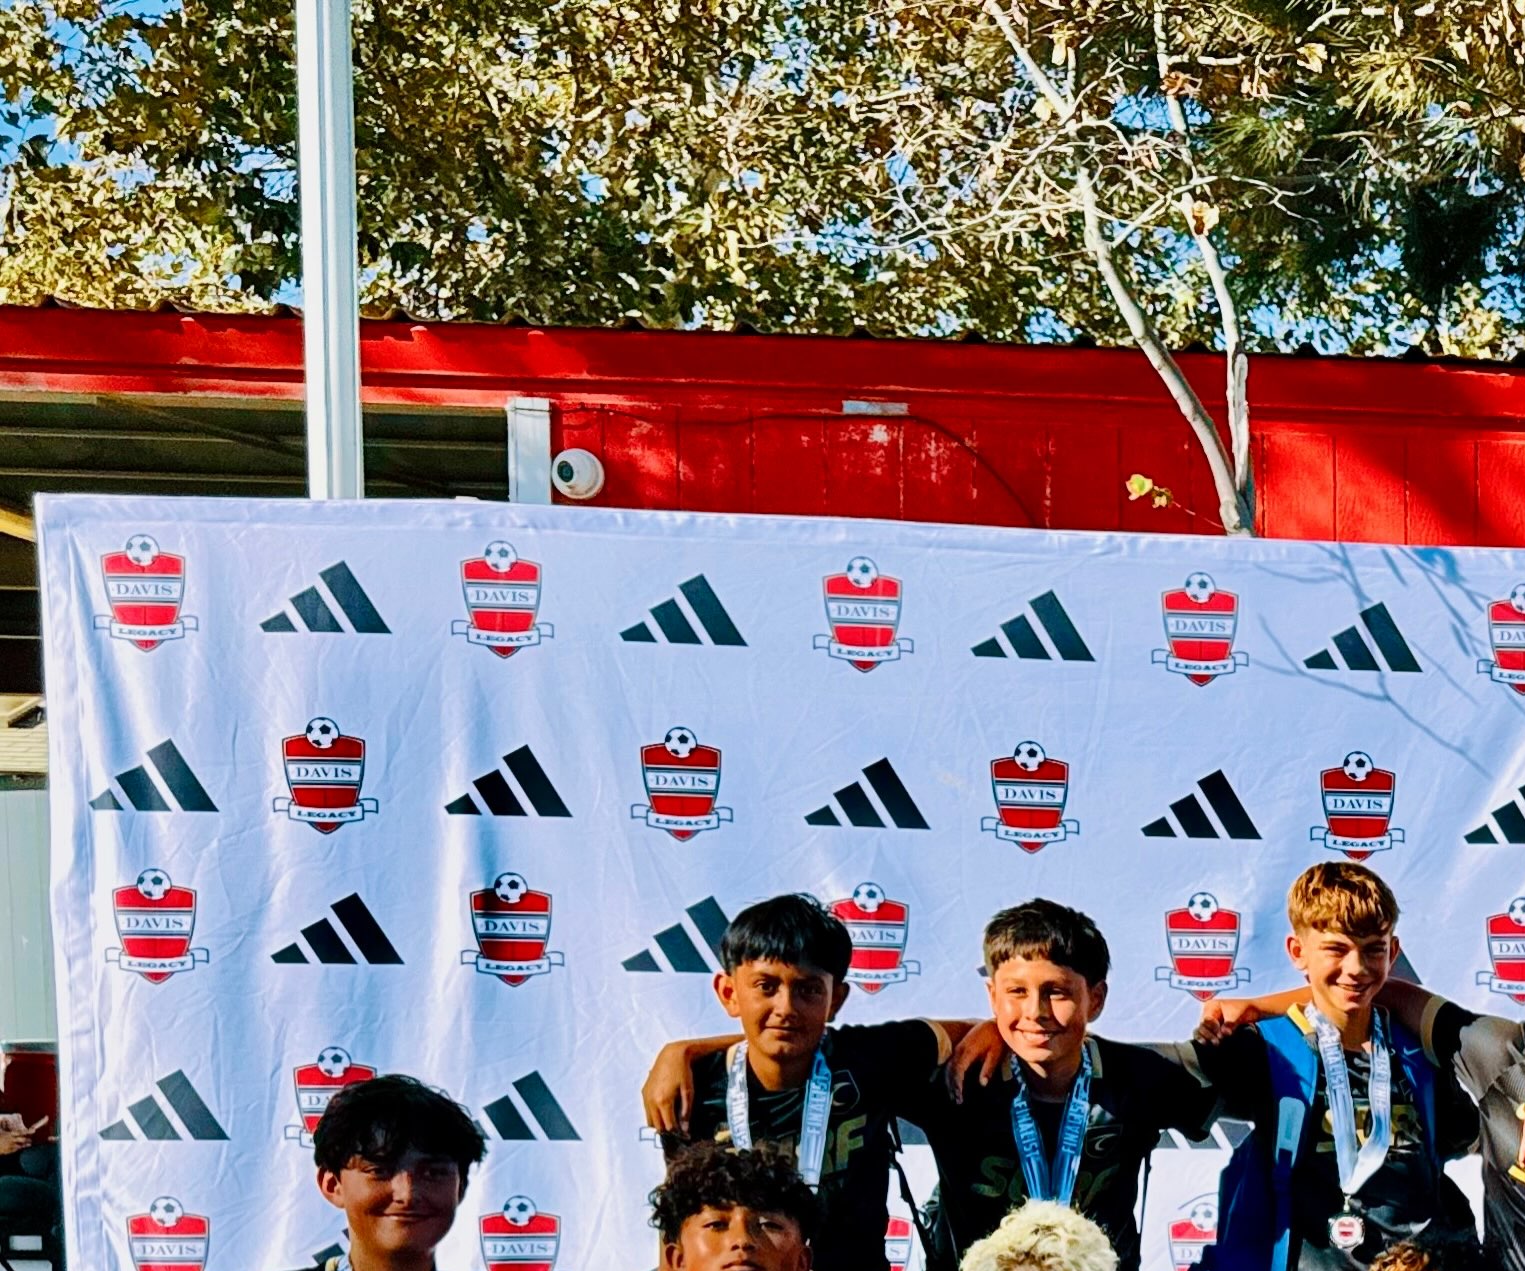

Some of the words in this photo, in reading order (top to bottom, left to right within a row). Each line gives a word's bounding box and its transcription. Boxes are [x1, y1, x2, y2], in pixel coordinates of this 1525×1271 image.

[116, 585, 174, 596] DAVIS
[475, 591, 531, 602] DAVIS
[837, 606, 891, 618] DAVIS
[1174, 620, 1227, 631] DAVIS
[119, 629, 177, 638] LEGACY
[476, 635, 533, 643] LEGACY
[838, 648, 893, 657] LEGACY
[1175, 663, 1228, 672] LEGACY
[296, 767, 353, 778] DAVIS
[654, 775, 709, 786] DAVIS
[1005, 789, 1057, 799] DAVIS
[1333, 799, 1383, 809] DAVIS
[297, 810, 355, 818] LEGACY
[655, 818, 711, 826] LEGACY
[1005, 831, 1059, 839] LEGACY
[1332, 839, 1385, 847] LEGACY
[126, 918, 183, 929] DAVIS
[484, 921, 539, 932] DAVIS
[1177, 938, 1229, 949] DAVIS
[127, 961, 185, 970] LEGACY
[485, 964, 542, 972] LEGACY
[1177, 980, 1230, 988] LEGACY
[807, 1074, 830, 1134] FINALIST
[1015, 1100, 1040, 1159] FINALIST
[142, 1245, 197, 1255] DAVIS
[493, 1243, 547, 1254] DAVIS
